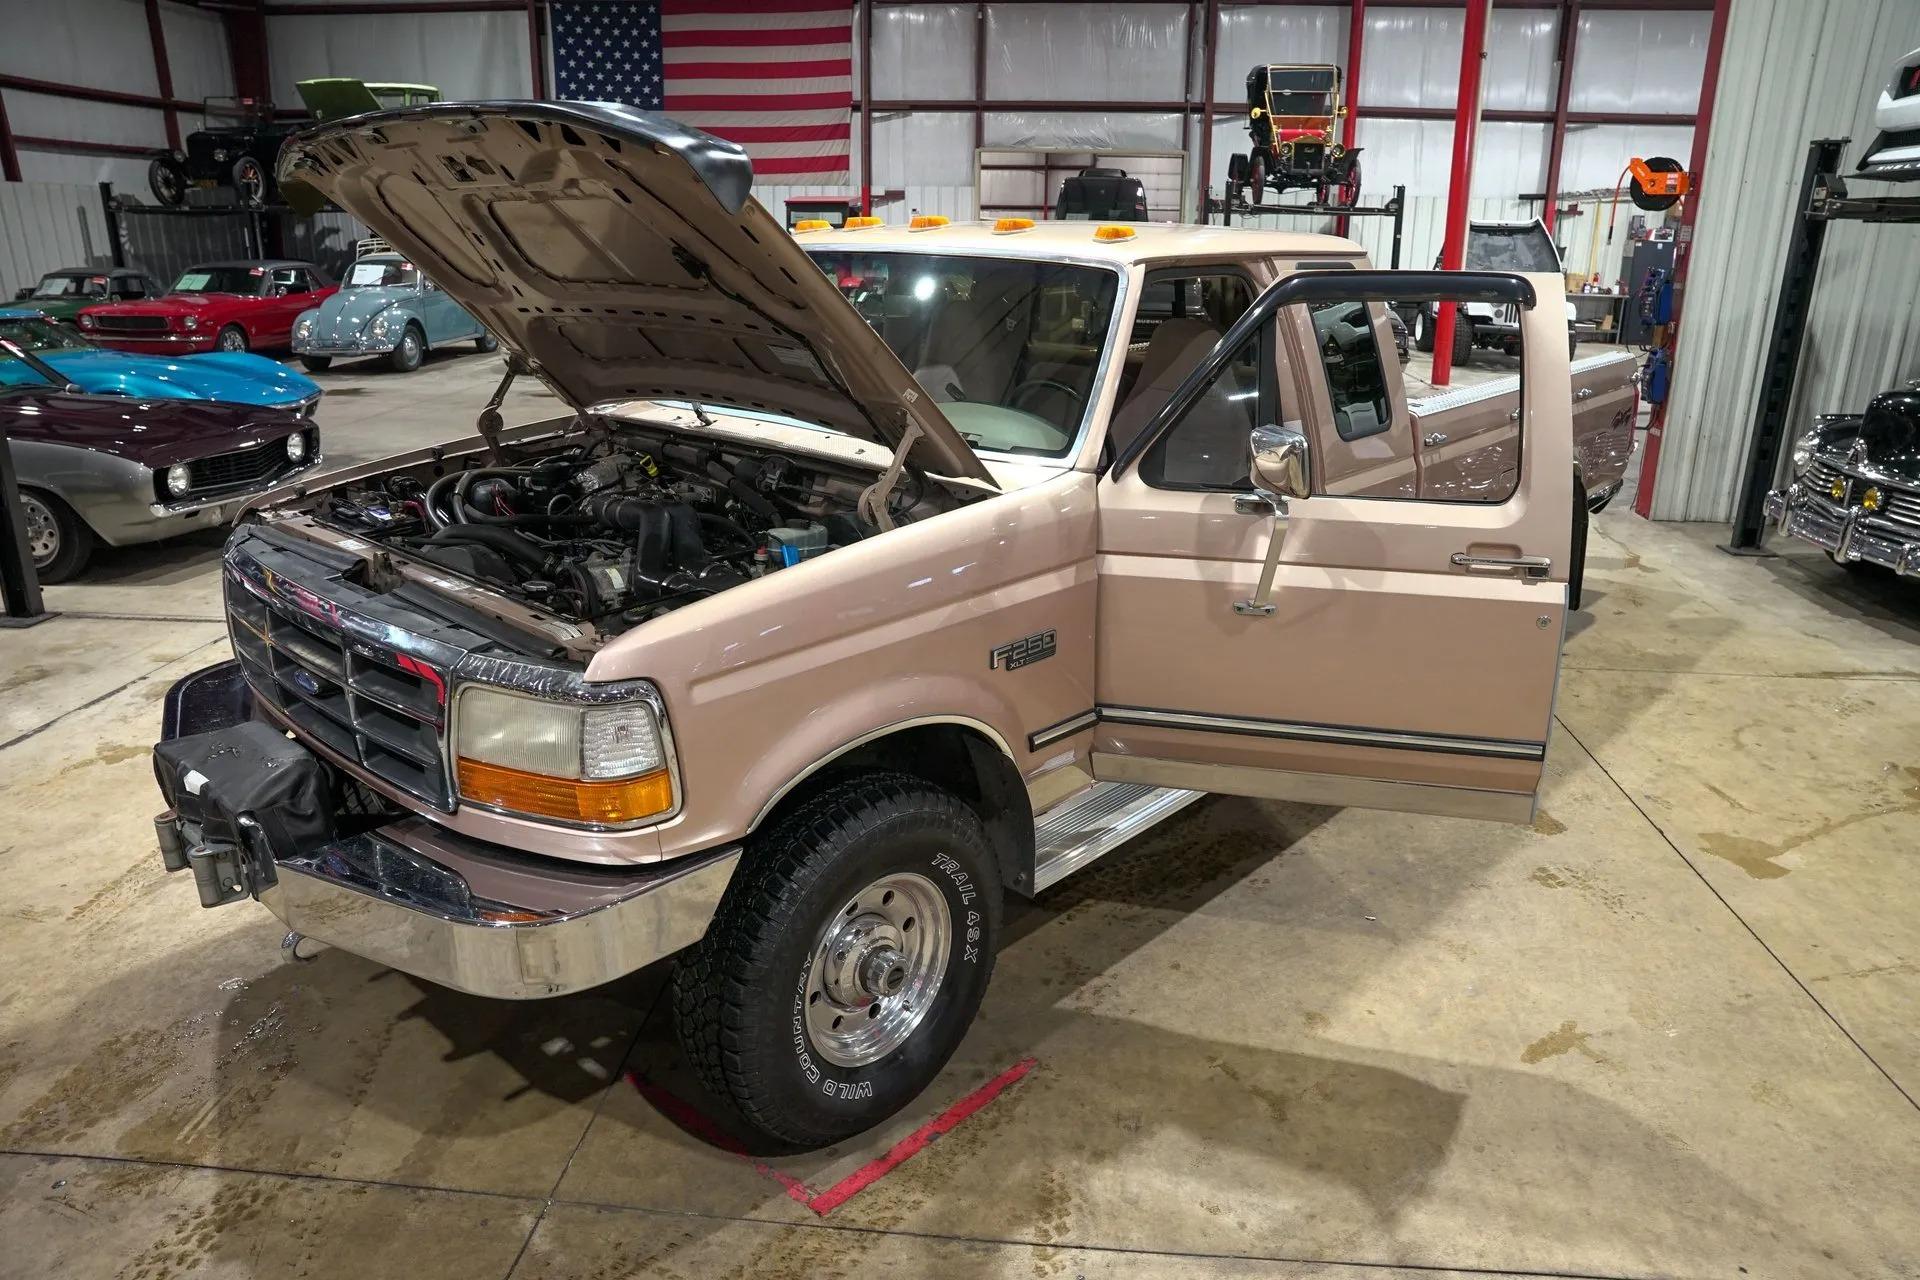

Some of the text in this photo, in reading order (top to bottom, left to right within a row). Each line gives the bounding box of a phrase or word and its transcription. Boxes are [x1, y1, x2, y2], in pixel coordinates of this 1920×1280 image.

[793, 852, 980, 1100] WILD COUNTRY TRAIL 4SX
